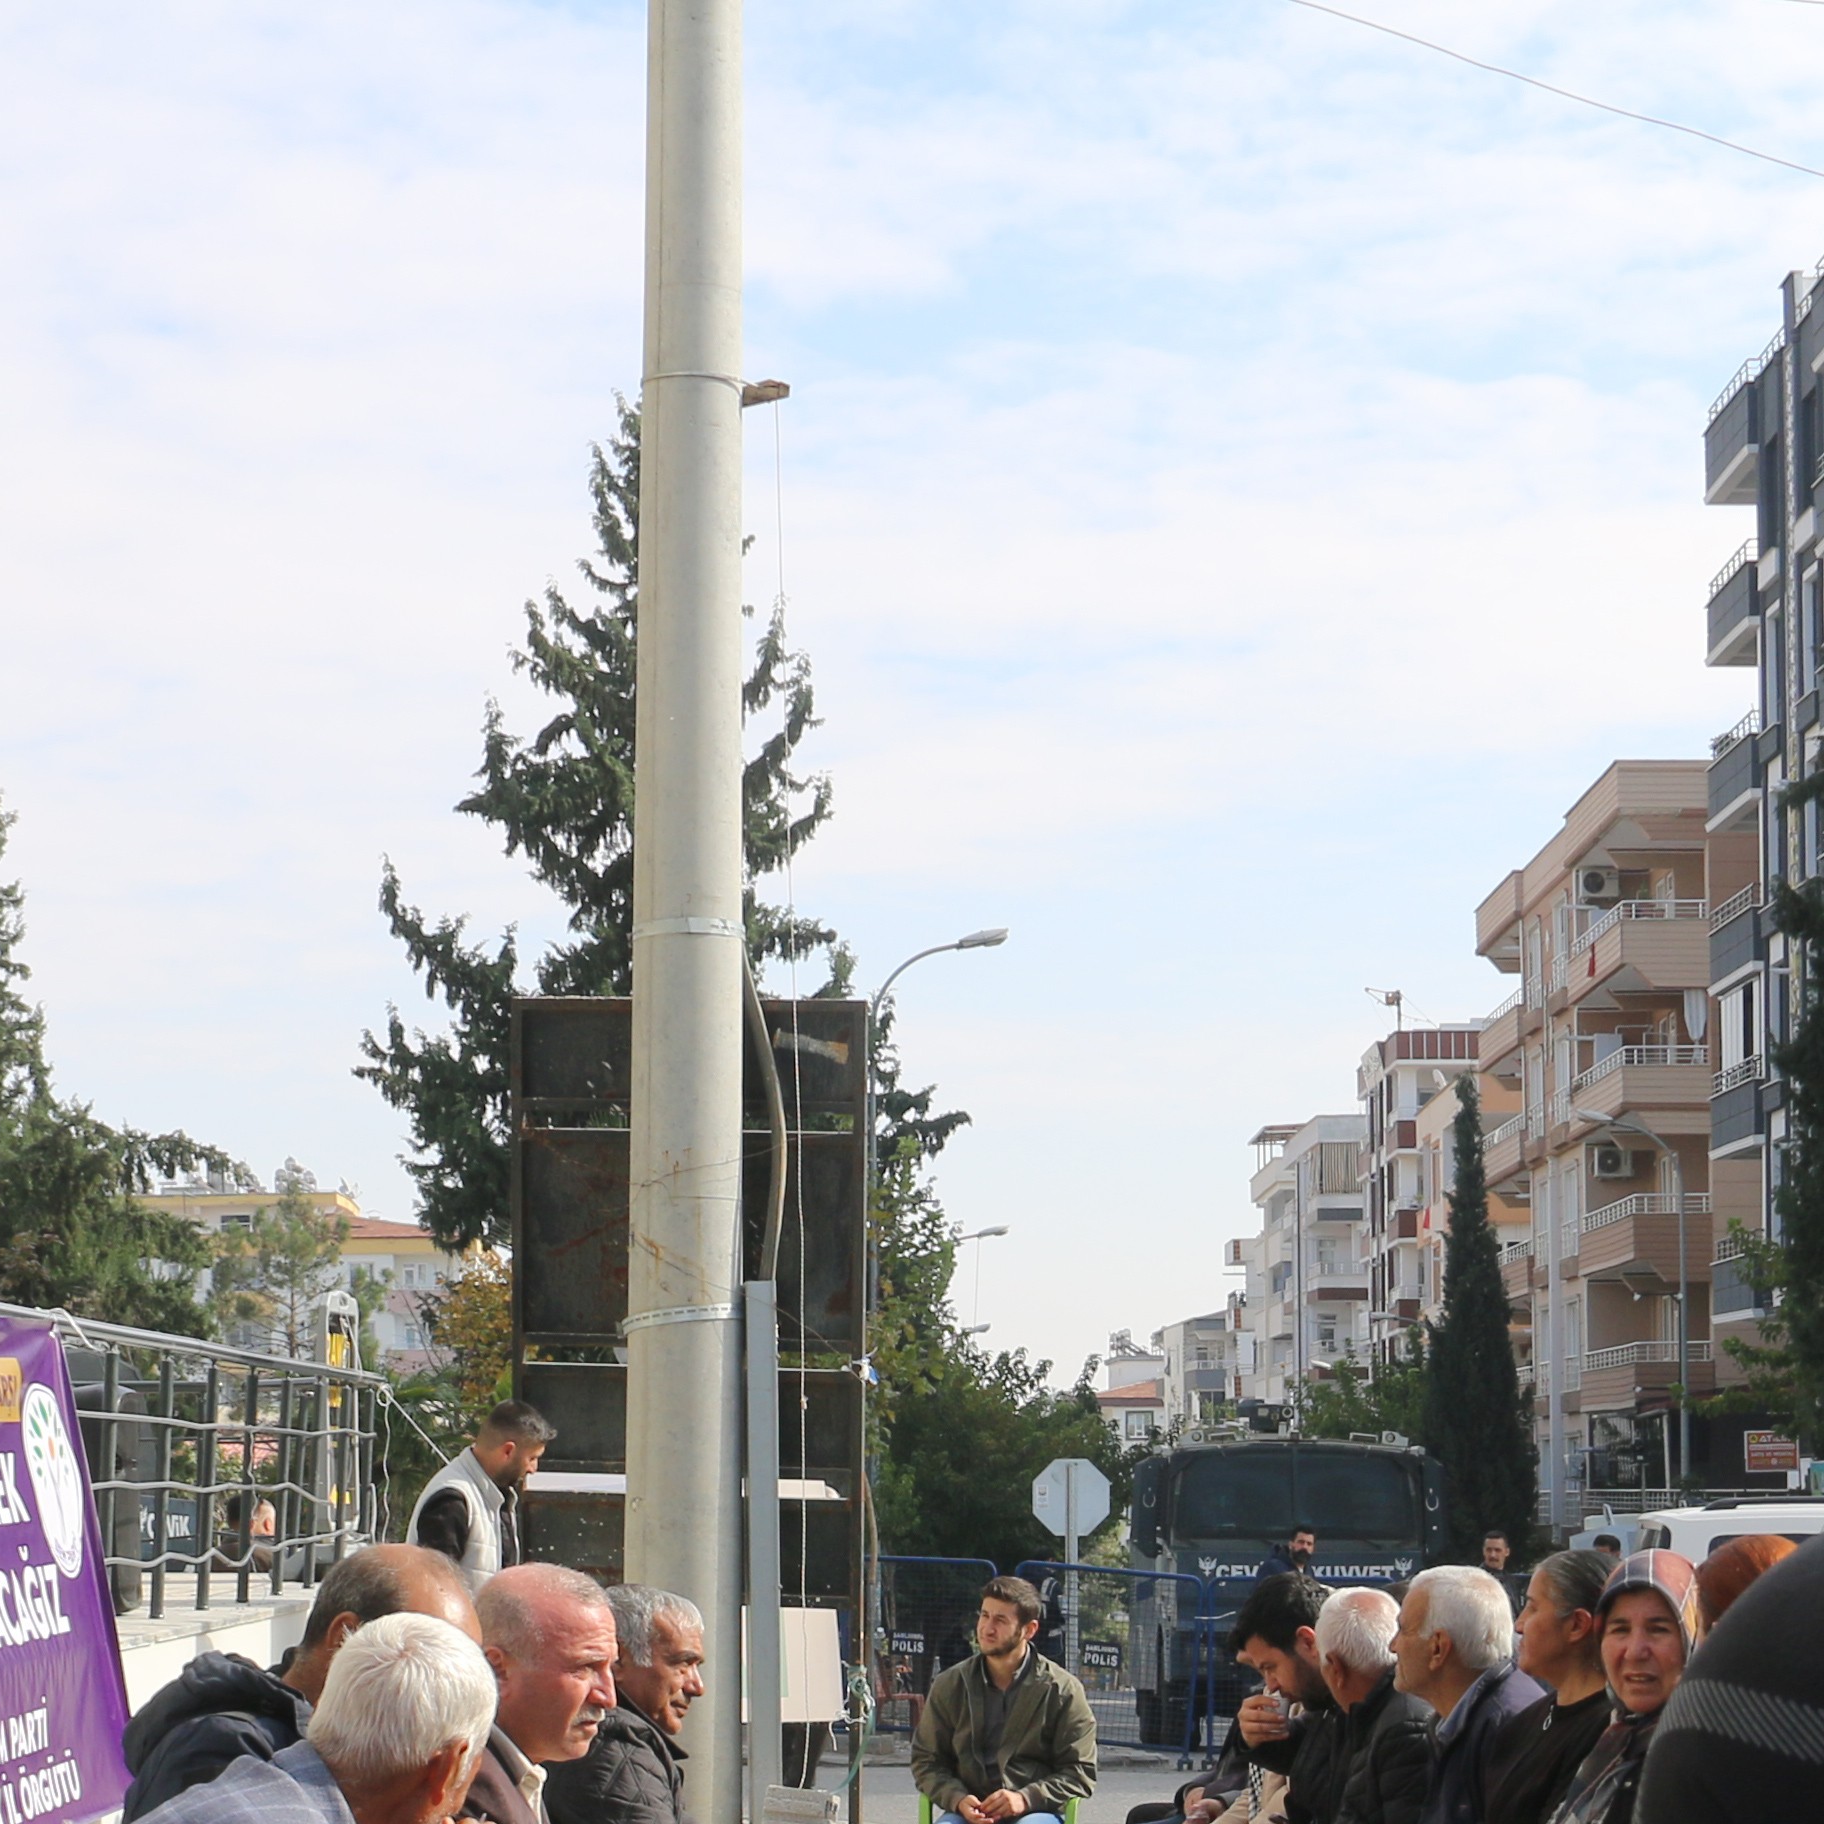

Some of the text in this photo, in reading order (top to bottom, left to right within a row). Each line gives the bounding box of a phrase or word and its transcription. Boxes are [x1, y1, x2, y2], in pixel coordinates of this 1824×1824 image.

[891, 1639, 925, 1654] POLİS
[1083, 1652, 1118, 1667] POLİS
[9, 1695, 49, 1760] PARTİ
[18, 1748, 81, 1821] ÖRGÜTÜ
